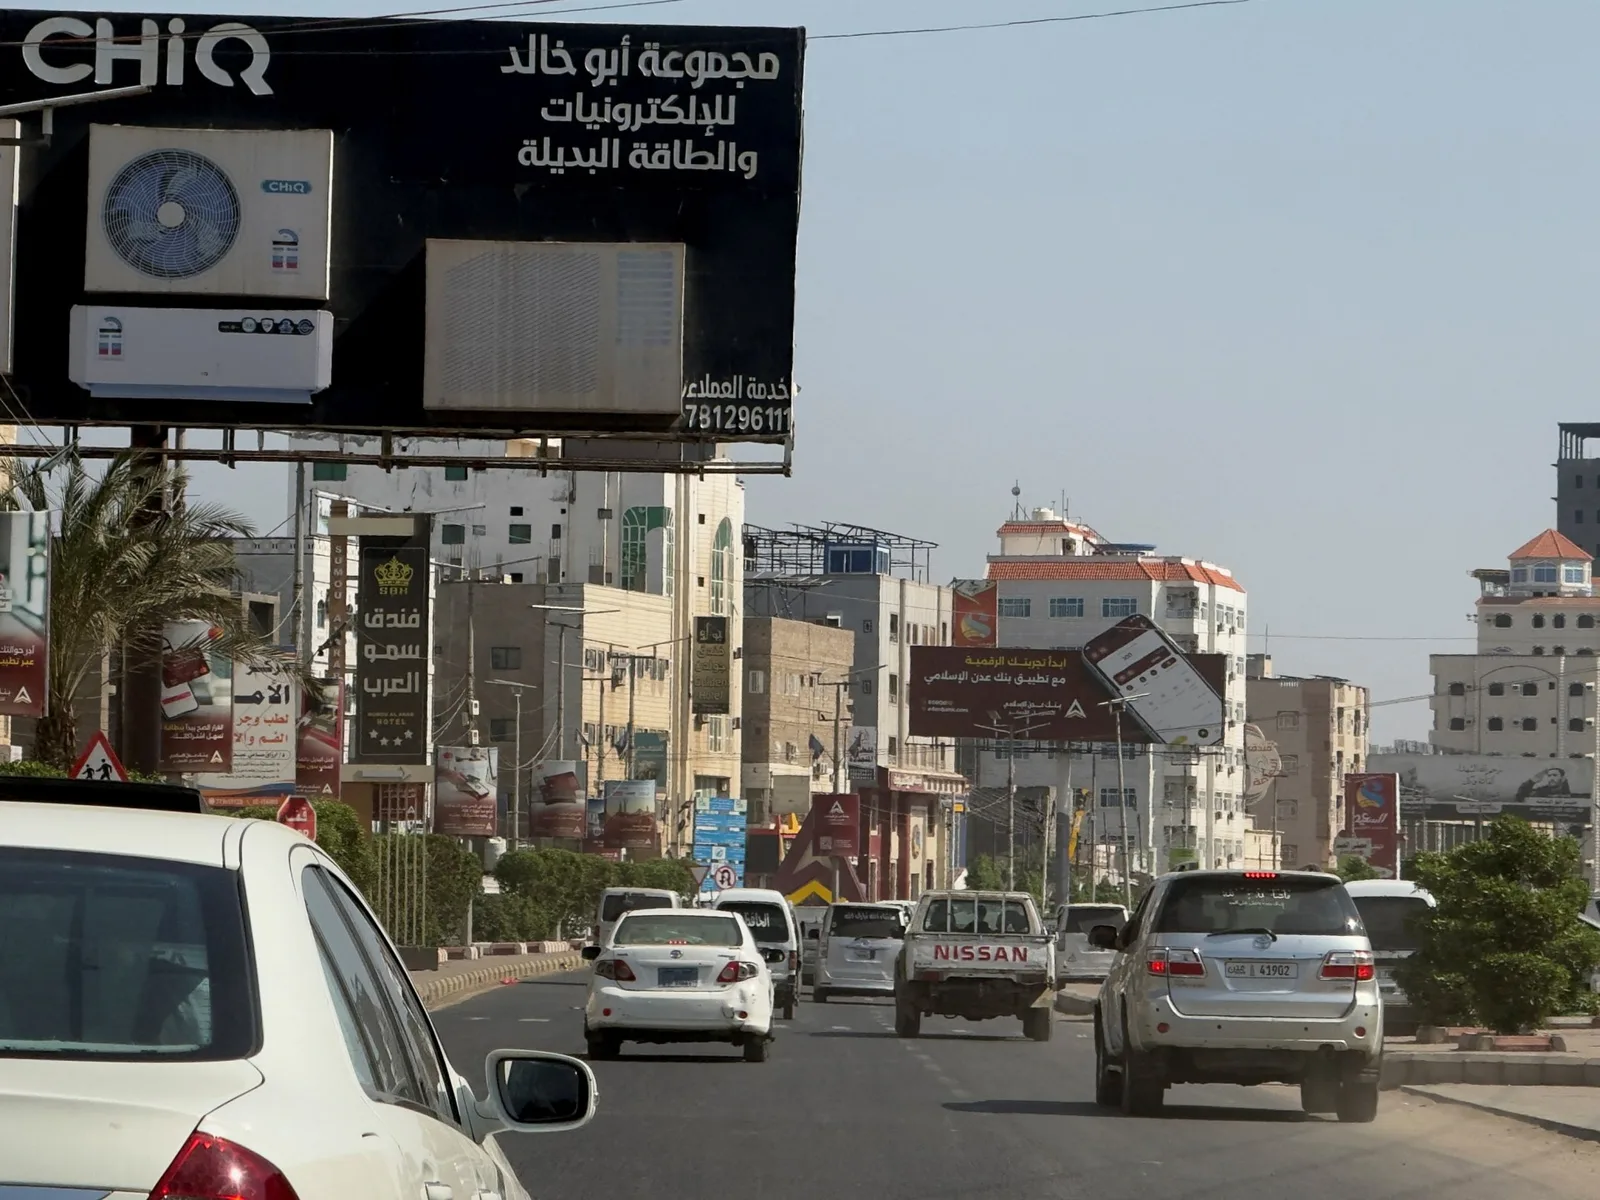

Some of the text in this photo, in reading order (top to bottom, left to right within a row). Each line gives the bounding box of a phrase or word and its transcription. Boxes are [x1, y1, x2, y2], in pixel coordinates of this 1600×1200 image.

[22, 17, 274, 96] CHiQ
[500, 33, 780, 89] مجموعة أبو خالد
[540, 92, 736, 137] للإلكترونيات
[517, 136, 758, 180] والطاقة البديلة
[746, 376, 790, 400] خدمة
[364, 608, 420, 628] فندق
[363, 644, 420, 663] سمو
[964, 655, 1005, 668] الرقمية
[363, 671, 420, 698] العرب
[923, 670, 1066, 687] مع تطبيق بنك عدن الإسلامي
[234, 680, 290, 705] الأم
[376, 718, 407, 726] HOTEL
[934, 944, 1028, 962] NISSAN
